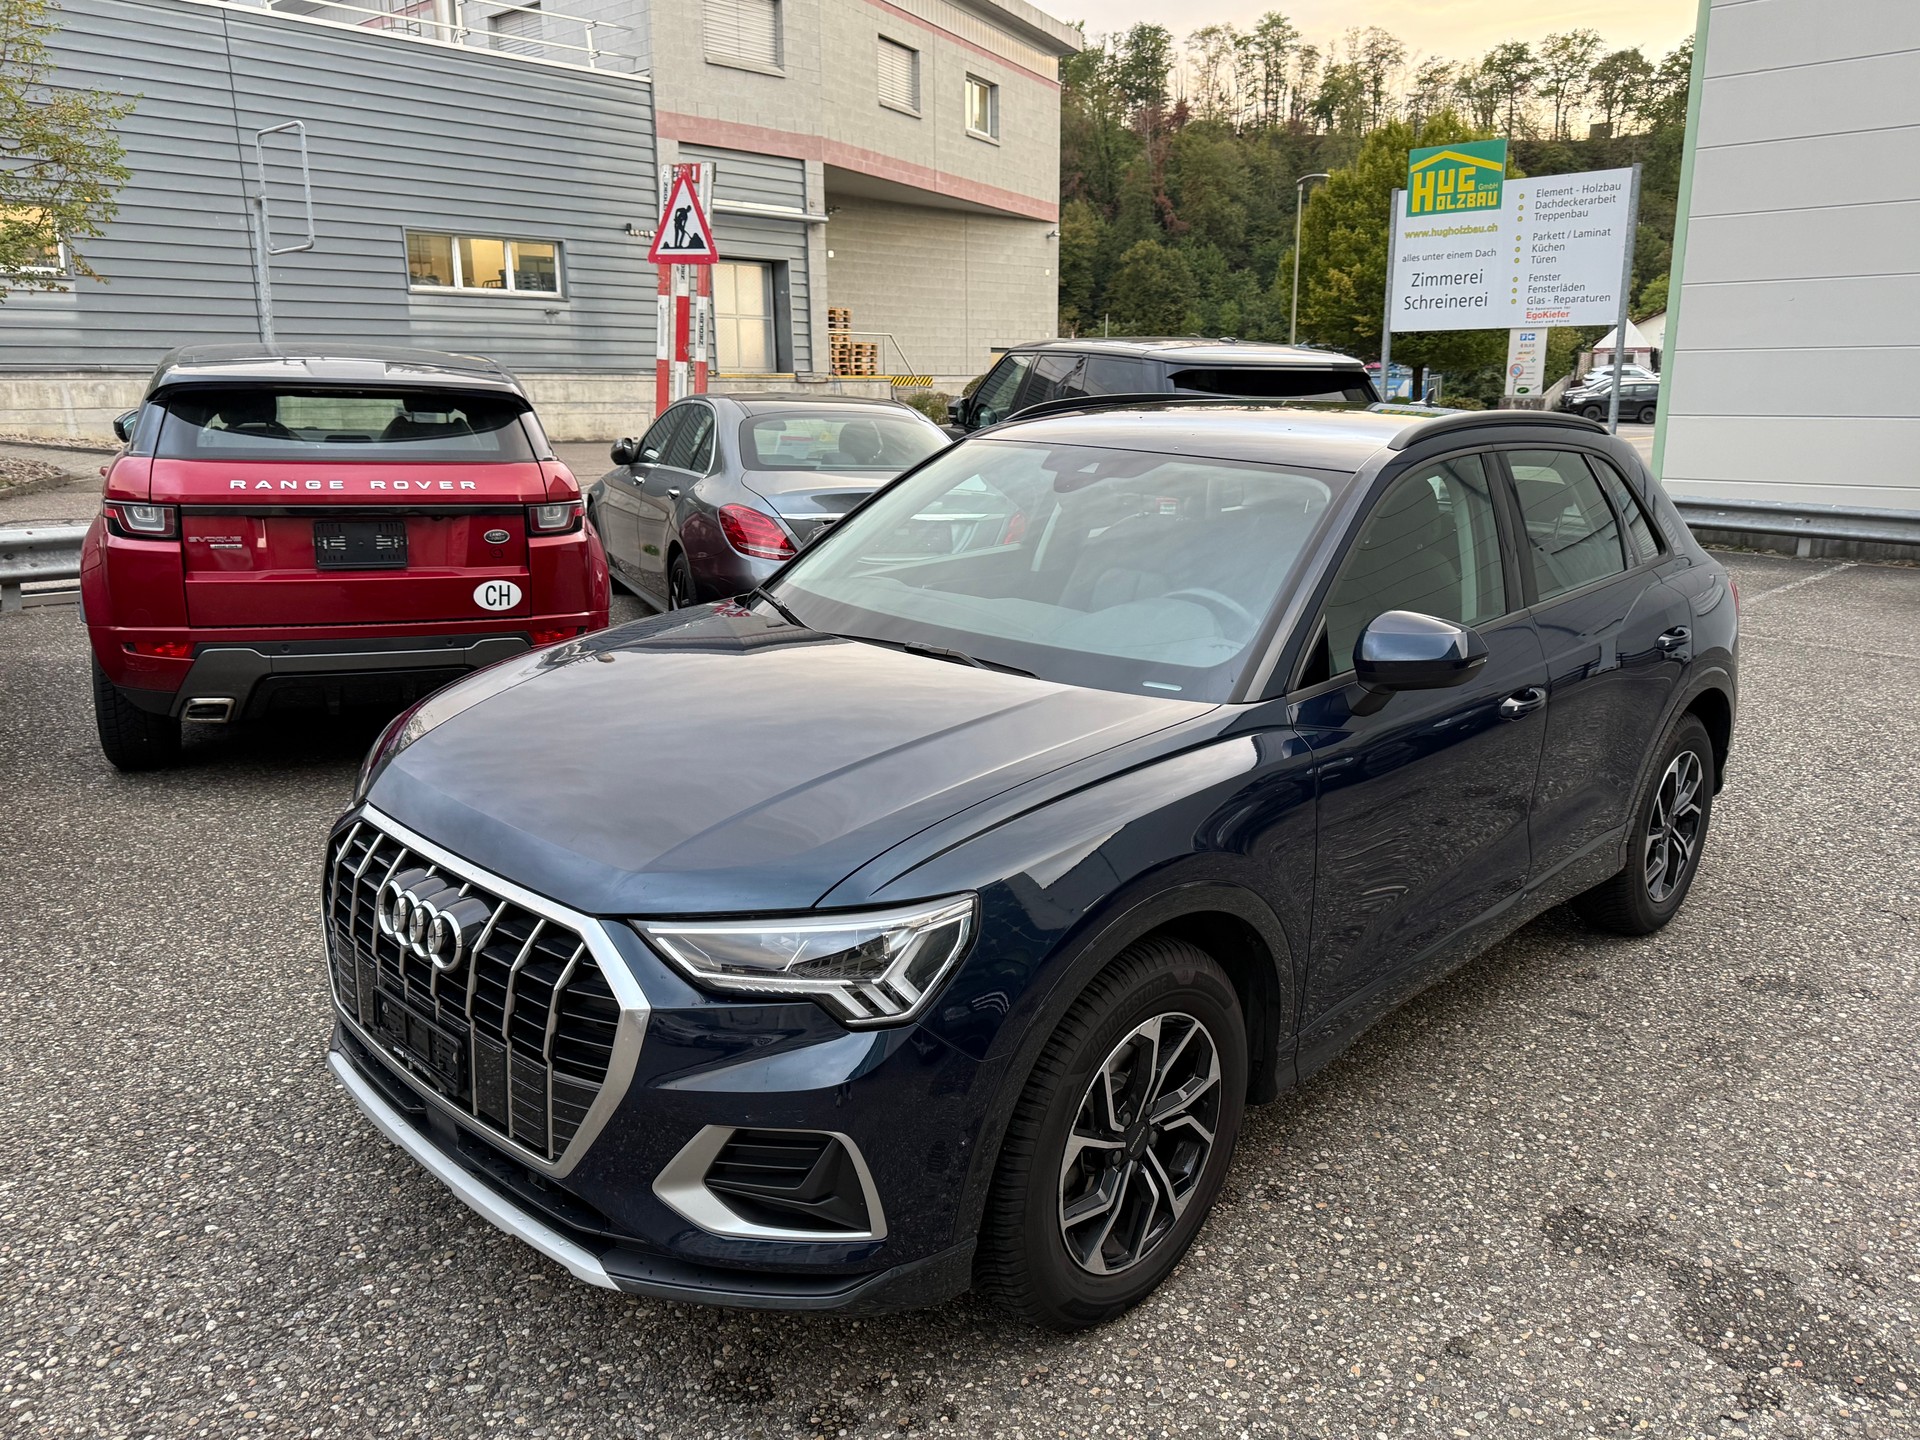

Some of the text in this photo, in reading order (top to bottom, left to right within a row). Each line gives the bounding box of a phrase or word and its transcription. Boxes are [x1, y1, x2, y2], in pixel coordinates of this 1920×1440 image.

[1412, 167, 1476, 212] HUG
[1478, 182, 1498, 190] GmbH
[1536, 187, 1573, 198] Element
[1582, 182, 1621, 194] Holzbau
[1535, 194, 1616, 210] Dachdeckerarbeit
[1534, 209, 1589, 222] Treppenbau
[1404, 223, 1498, 239] www.hugholzbau.ch
[1532, 231, 1565, 241] Parkett
[1573, 228, 1611, 239] Laminat
[1402, 247, 1497, 262] alles unter einem Dach
[1532, 243, 1566, 253] Küchen
[1531, 255, 1557, 264] Türen
[1411, 268, 1483, 287] Zimmerei
[1528, 273, 1561, 282] Fenster
[1527, 282, 1586, 294] Fensterläden
[1404, 291, 1488, 310] Schreinerei
[1527, 296, 1546, 305] Glas
[1553, 294, 1611, 305] Reparaturen
[1526, 311, 1570, 320] EgoKiefer
[229, 479, 477, 490] RANGE ROVER
[485, 584, 511, 607] CH
